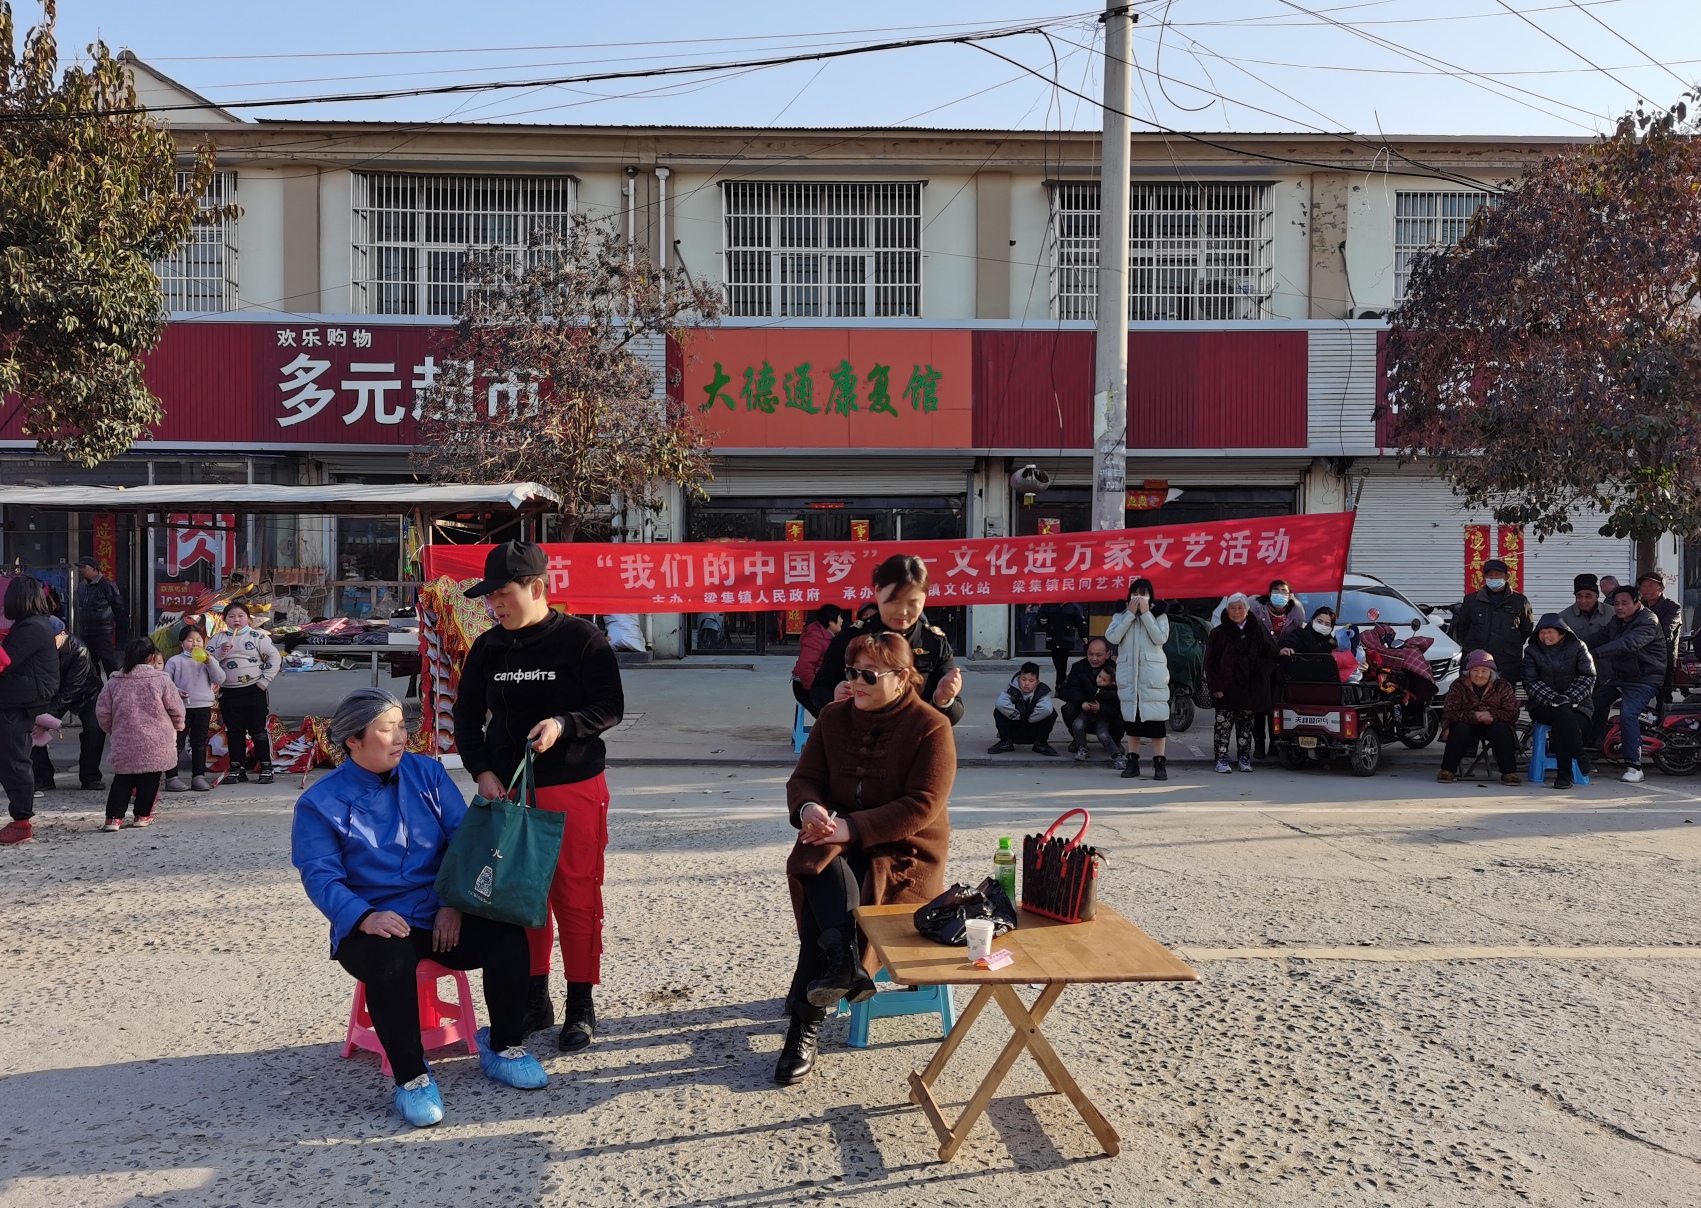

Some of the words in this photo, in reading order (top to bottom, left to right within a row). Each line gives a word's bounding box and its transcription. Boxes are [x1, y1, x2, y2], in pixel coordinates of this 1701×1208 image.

[276, 328, 372, 348] 欢乐购物
[275, 352, 546, 428] 多元超市
[703, 359, 943, 418] 大德通康复馆
[547, 555, 572, 594] 节
